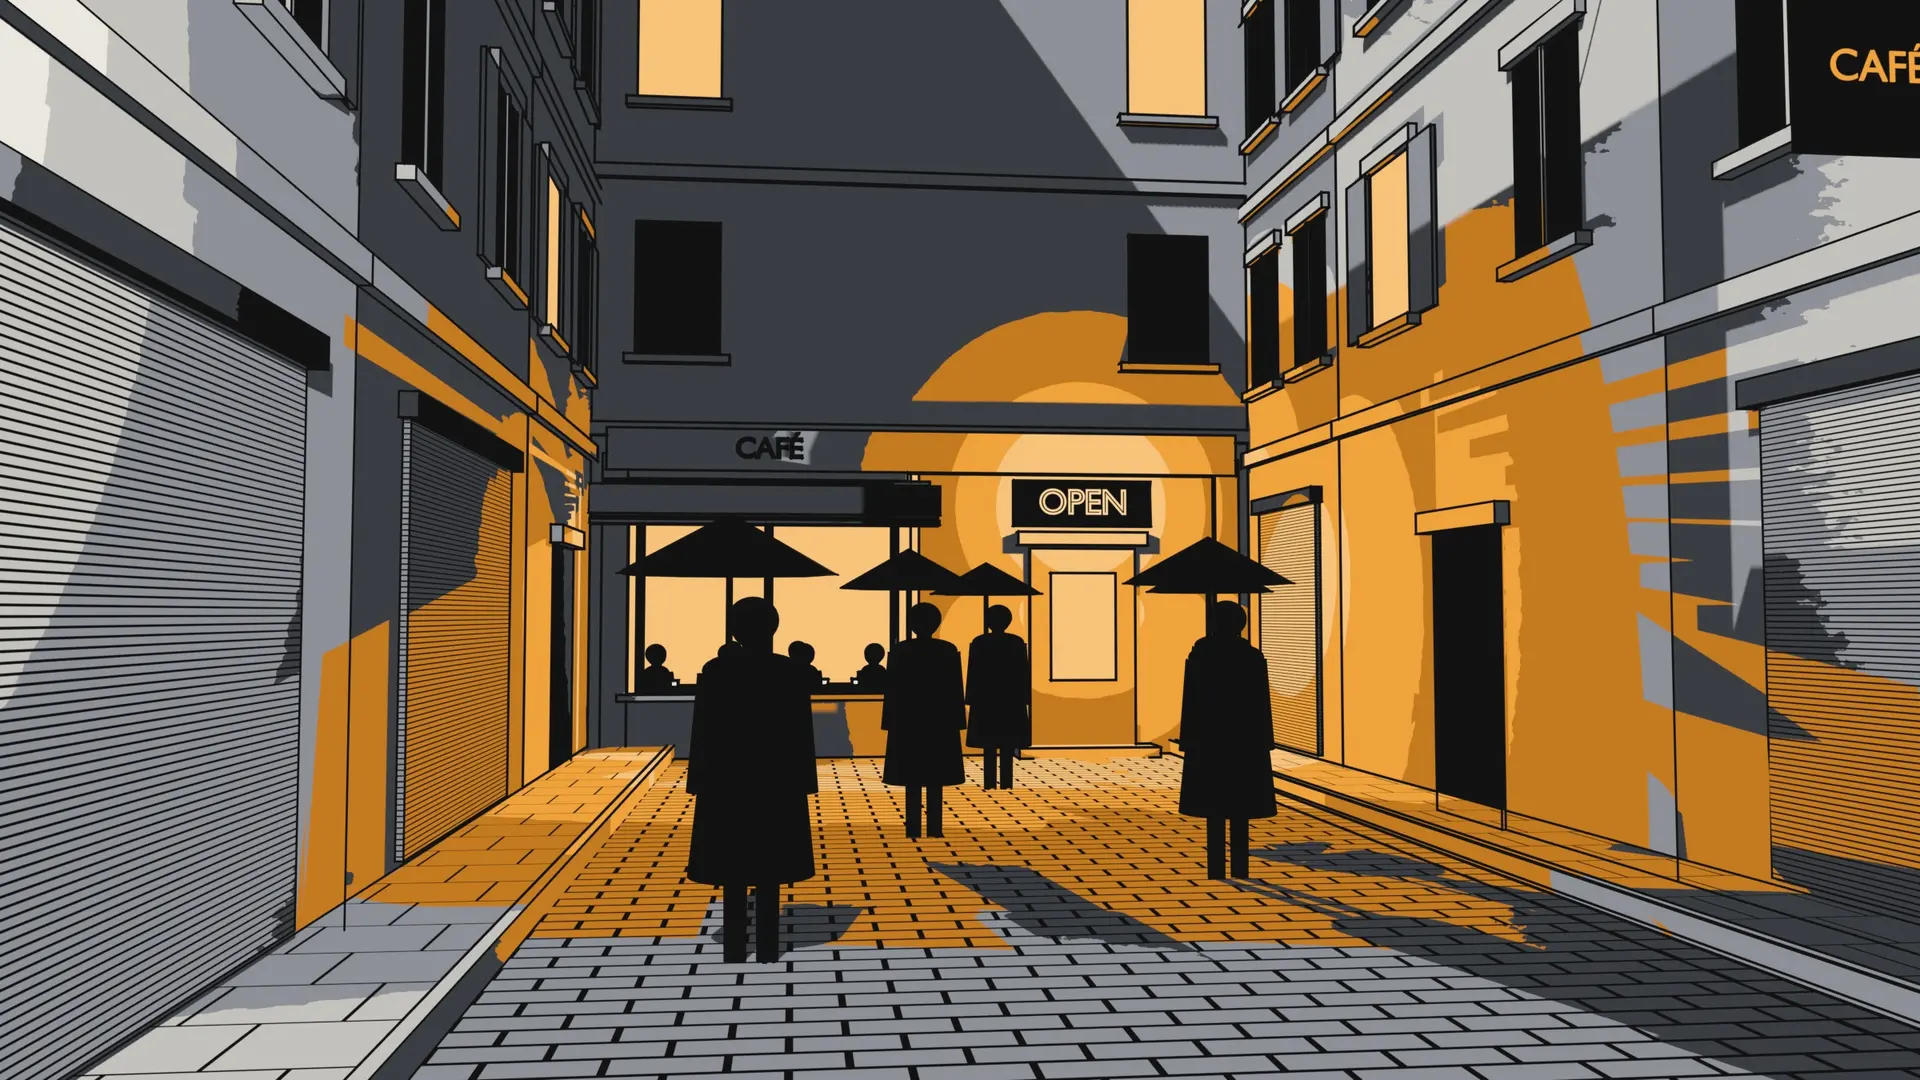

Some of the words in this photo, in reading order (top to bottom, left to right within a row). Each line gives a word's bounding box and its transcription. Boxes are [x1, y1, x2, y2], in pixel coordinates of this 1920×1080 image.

[1829, 43, 1920, 84] CAFÉ
[735, 432, 804, 460] CAFÉ
[1039, 488, 1127, 516] OPEN
